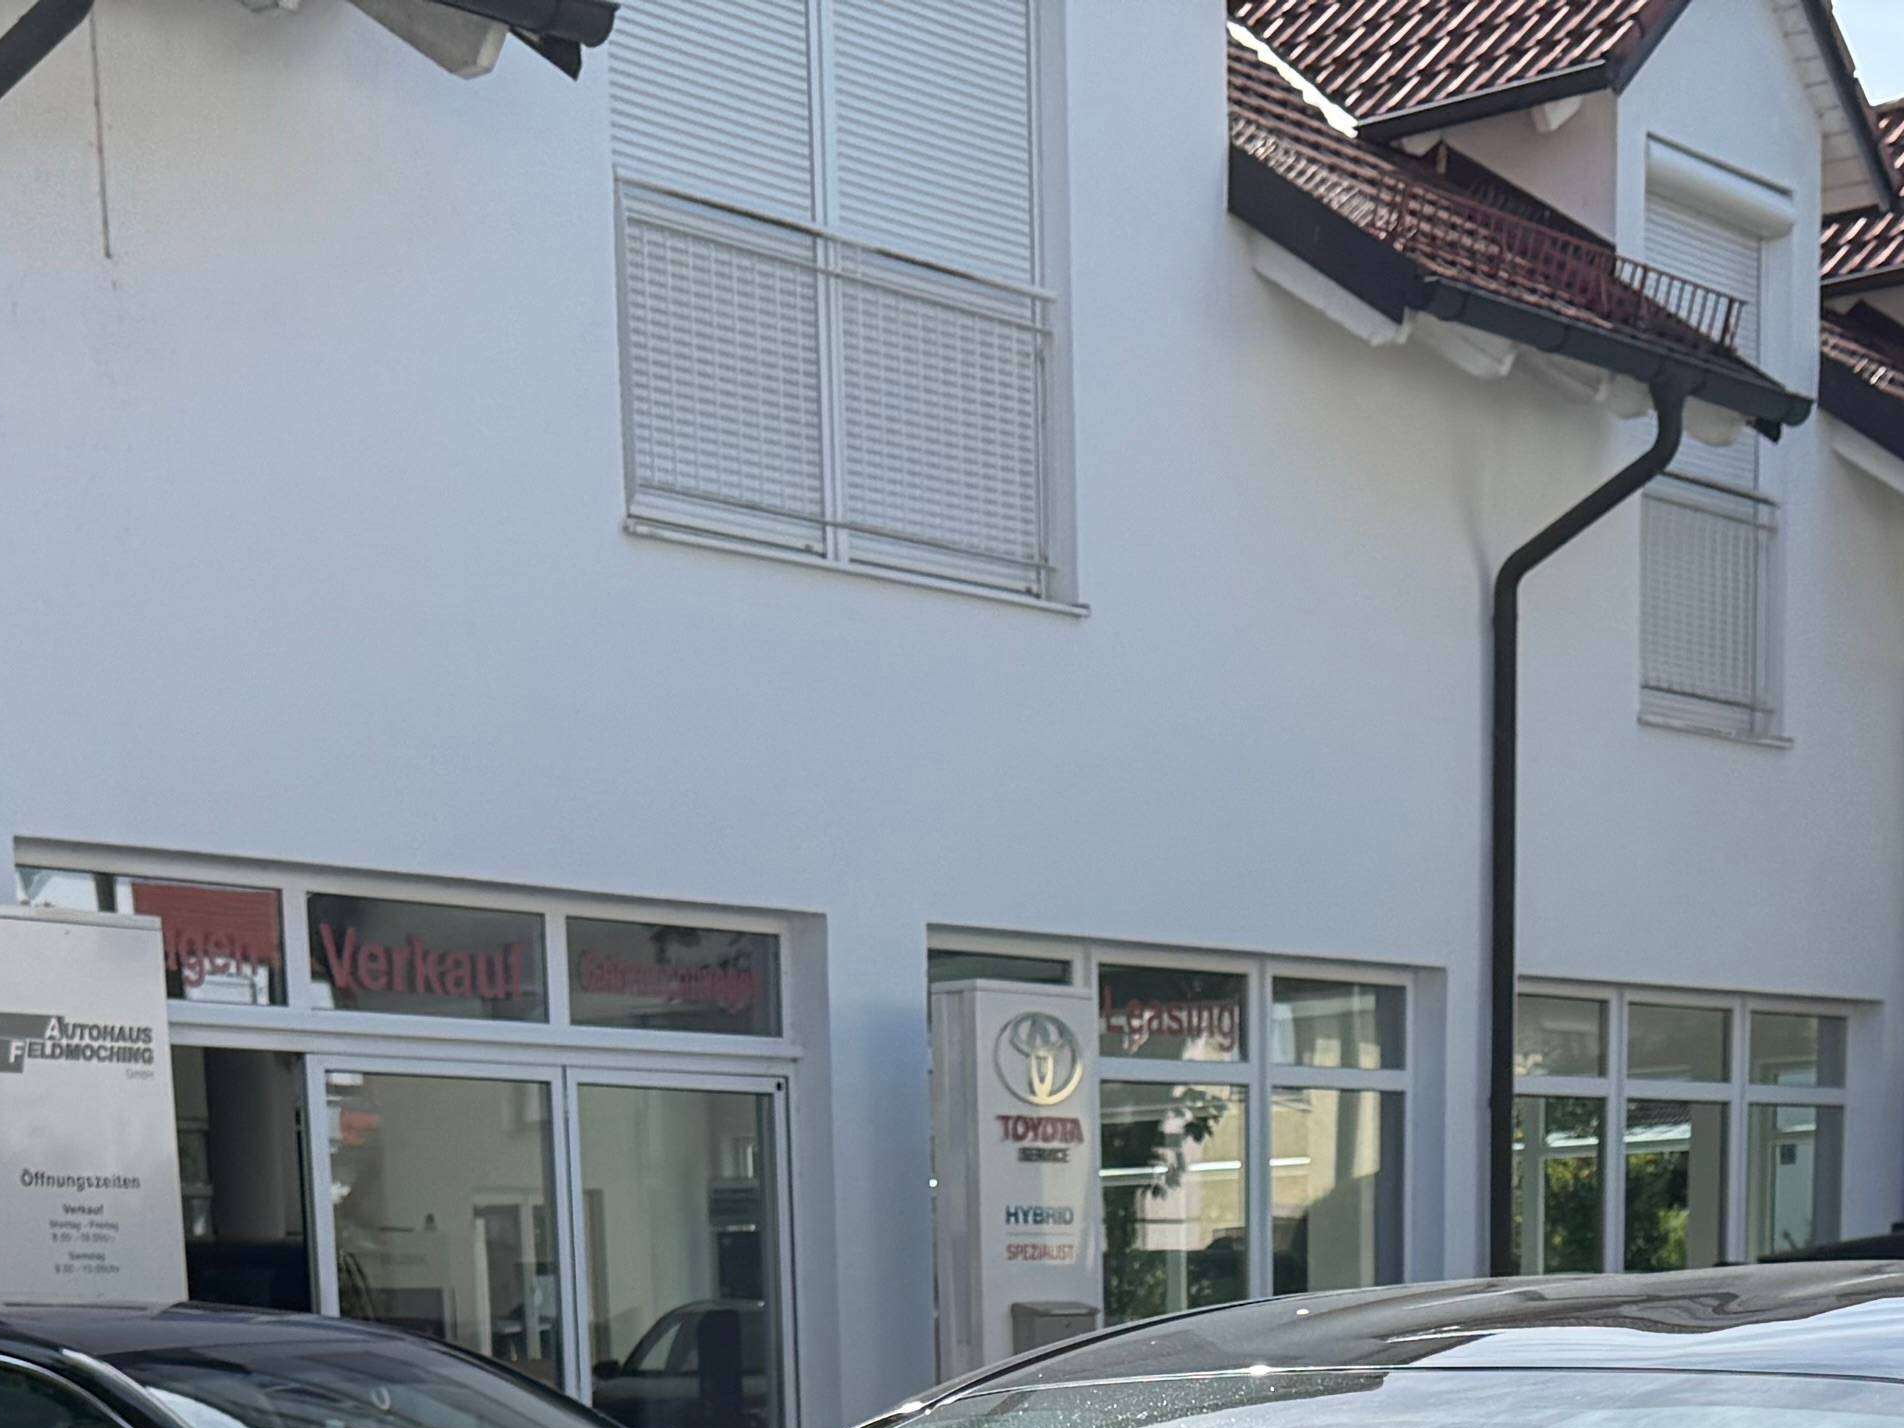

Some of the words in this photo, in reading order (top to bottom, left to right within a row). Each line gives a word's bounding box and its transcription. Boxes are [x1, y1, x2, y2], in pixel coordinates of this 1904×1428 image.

[320, 921, 525, 1000] Verkauf
[45, 1015, 154, 1044] AUTOHAUS
[1103, 984, 1236, 1053] Leasing
[8, 1040, 156, 1065] FELDMOCHING
[996, 1114, 1085, 1145] TOYOTA
[20, 1168, 141, 1192] Öffnungszeiten
[1005, 1204, 1075, 1226] HYBRID
